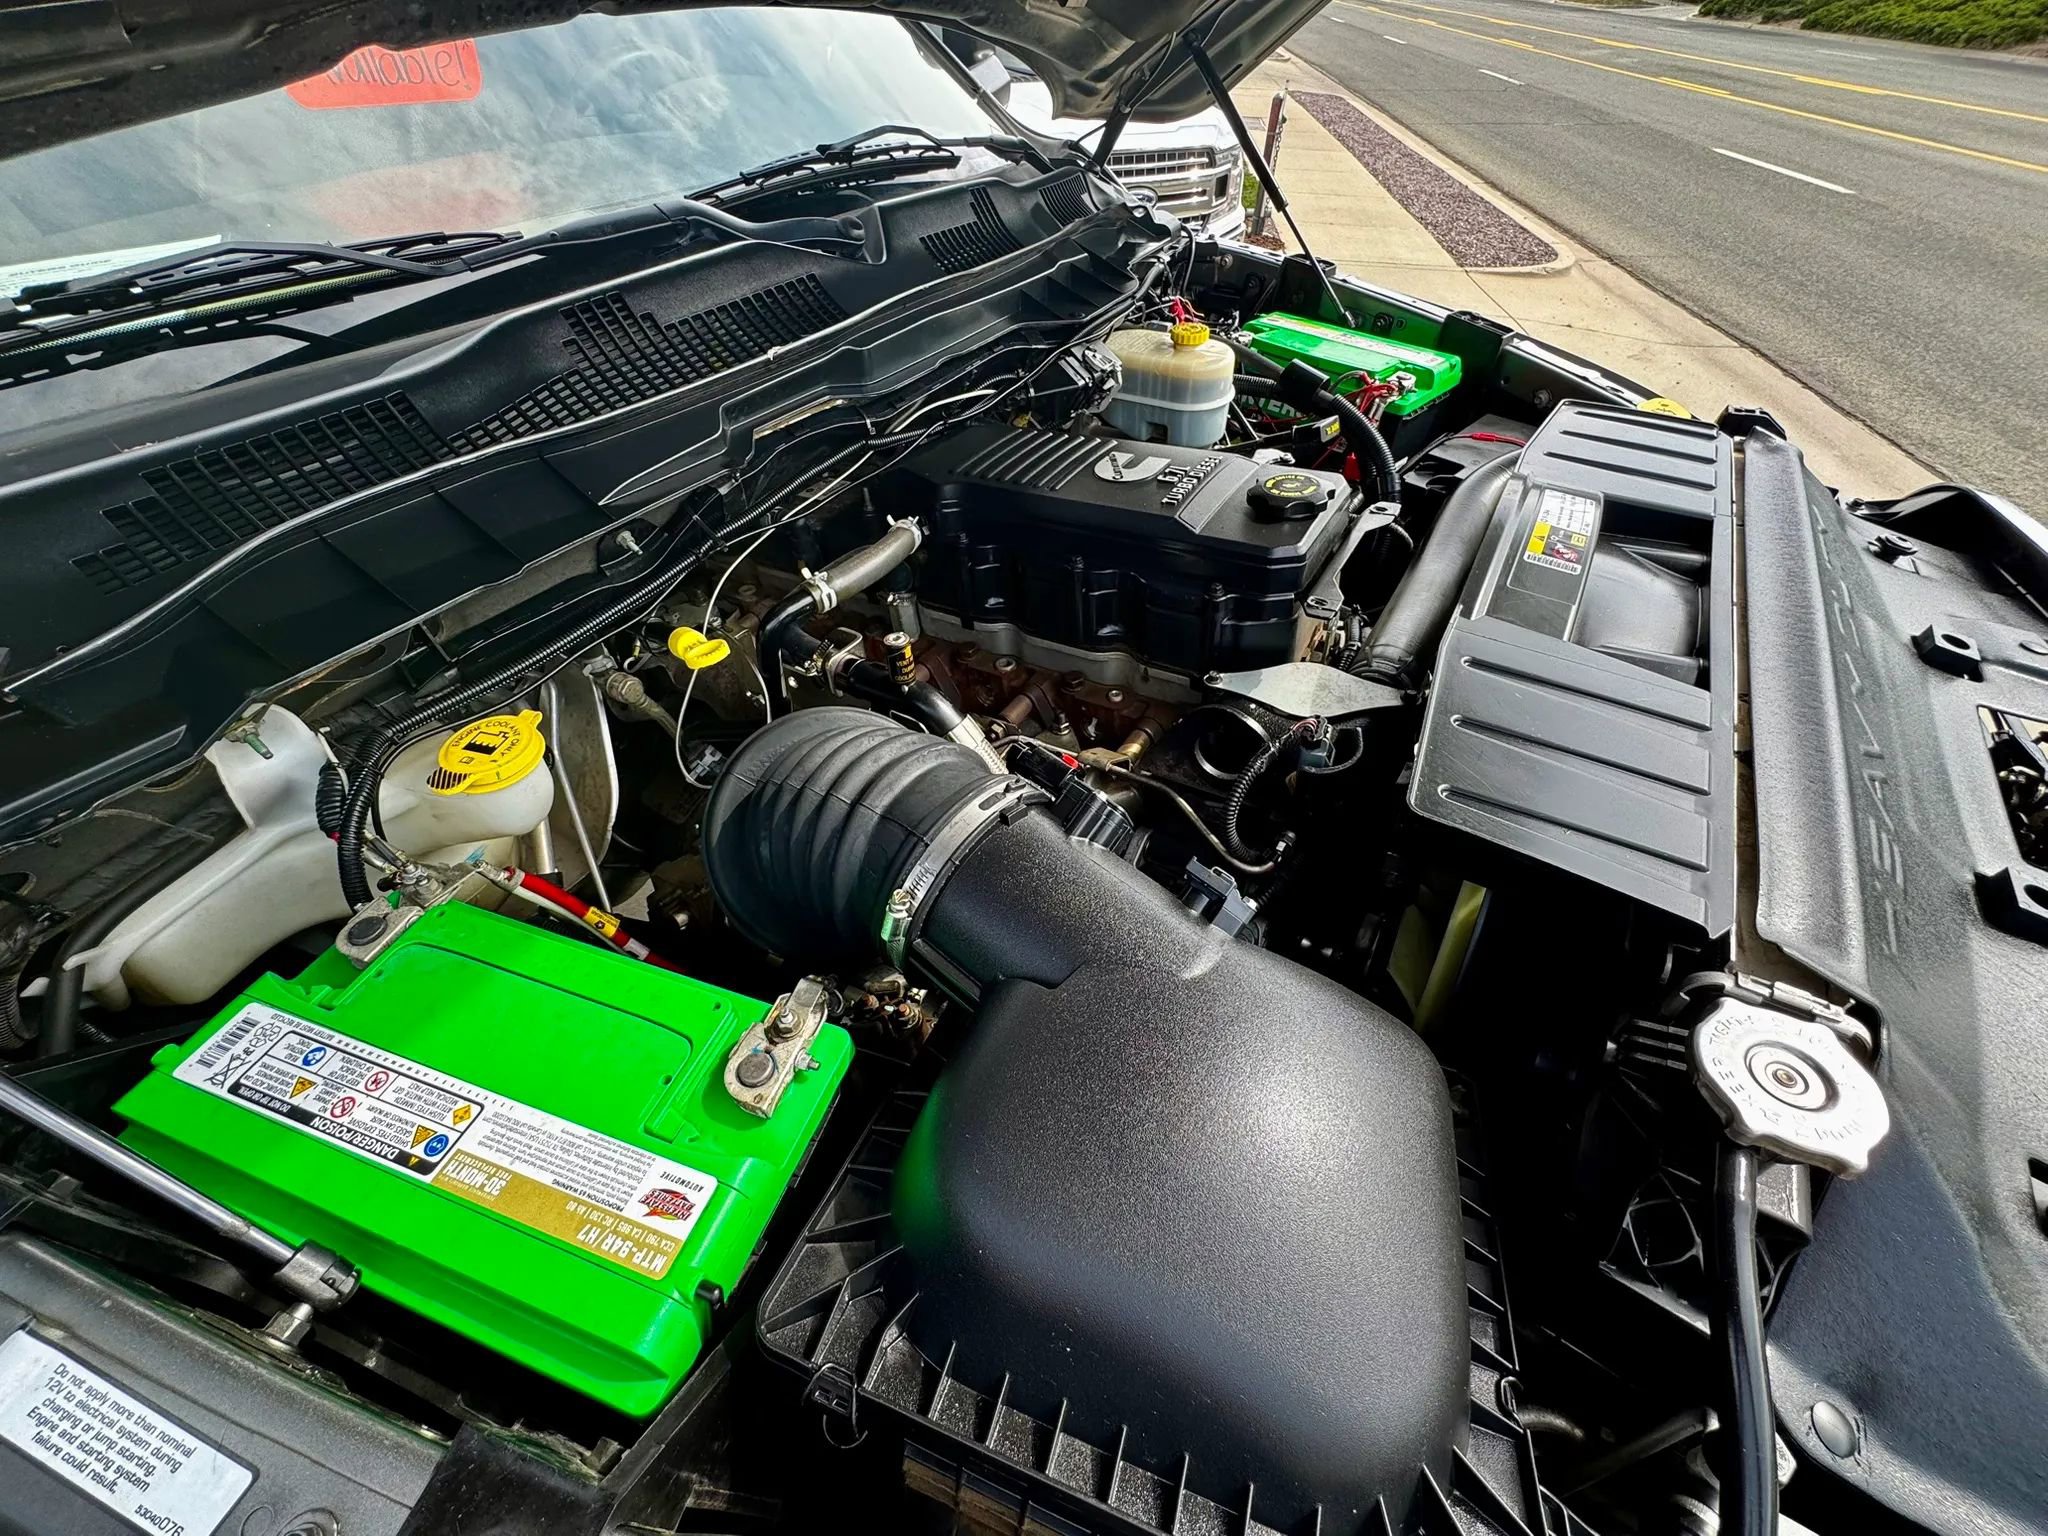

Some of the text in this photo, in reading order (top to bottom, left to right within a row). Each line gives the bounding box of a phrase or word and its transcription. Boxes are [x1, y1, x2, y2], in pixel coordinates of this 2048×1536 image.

[452, 721, 520, 757] ENGINE COOLANT ONLY
[269, 1012, 295, 1026] RECYCLED
[298, 1023, 315, 1033] MUST
[312, 1028, 335, 1041] BATTERY
[240, 1046, 255, 1056] Pb
[283, 1052, 299, 1062] READ
[327, 1069, 361, 1086] KEEP OUT OF
[338, 1064, 368, 1079] THE REACH
[363, 1064, 374, 1072] OF
[242, 1074, 289, 1097] SULFURIC ACID CAN
[254, 1069, 294, 1088] CAUSE BLINDNESS
[235, 1085, 291, 1112] DO NOT TIP OR OPEN.
[312, 1094, 332, 1105] SPARKS
[319, 1087, 338, 1097] FLAMES
[391, 1085, 405, 1095] GET
[419, 1086, 436, 1097] HELP
[433, 1092, 459, 1106] MEDICAL
[317, 1104, 329, 1113] NO
[414, 1104, 430, 1114] EYES
[421, 1097, 438, 1107] WITH
[435, 1102, 453, 1113] ATELY
[382, 1110, 392, 1118] OR
[389, 1113, 416, 1128] BLINDNESS
[426, 1109, 447, 1121] FLUSH
[346, 1116, 411, 1147] SHIELD EYES. EXPLOSIVE
[369, 1115, 413, 1137] GASES CAN CAUSE
[308, 1115, 400, 1159] DANGER/POISON
[453, 1152, 512, 1180] FREE REPLACEMENT
[441, 1159, 507, 1196] 30-MONTH
[659, 1170, 704, 1193] AUTOMOTIVE
[551, 1178, 625, 1212] PROPOSITION 65 WARNING
[647, 1187, 695, 1211] BATTERIES
[637, 1193, 692, 1221] INTERSTATE
[564, 1200, 676, 1251] CCA 790 CA 985 RC 130 Ah 80
[574, 1221, 669, 1274] MTP-94R/H7
[53, 1362, 196, 1459] Do not apply more than nominal
[43, 1376, 183, 1474] 12V to electrical system during
[39, 1395, 159, 1479] charging or jump starting.
[25, 1404, 150, 1496] Engine and starting system
[31, 1428, 64, 1456] failure
[60, 1447, 90, 1473] could
[134, 1504, 184, 1536] 53040076
